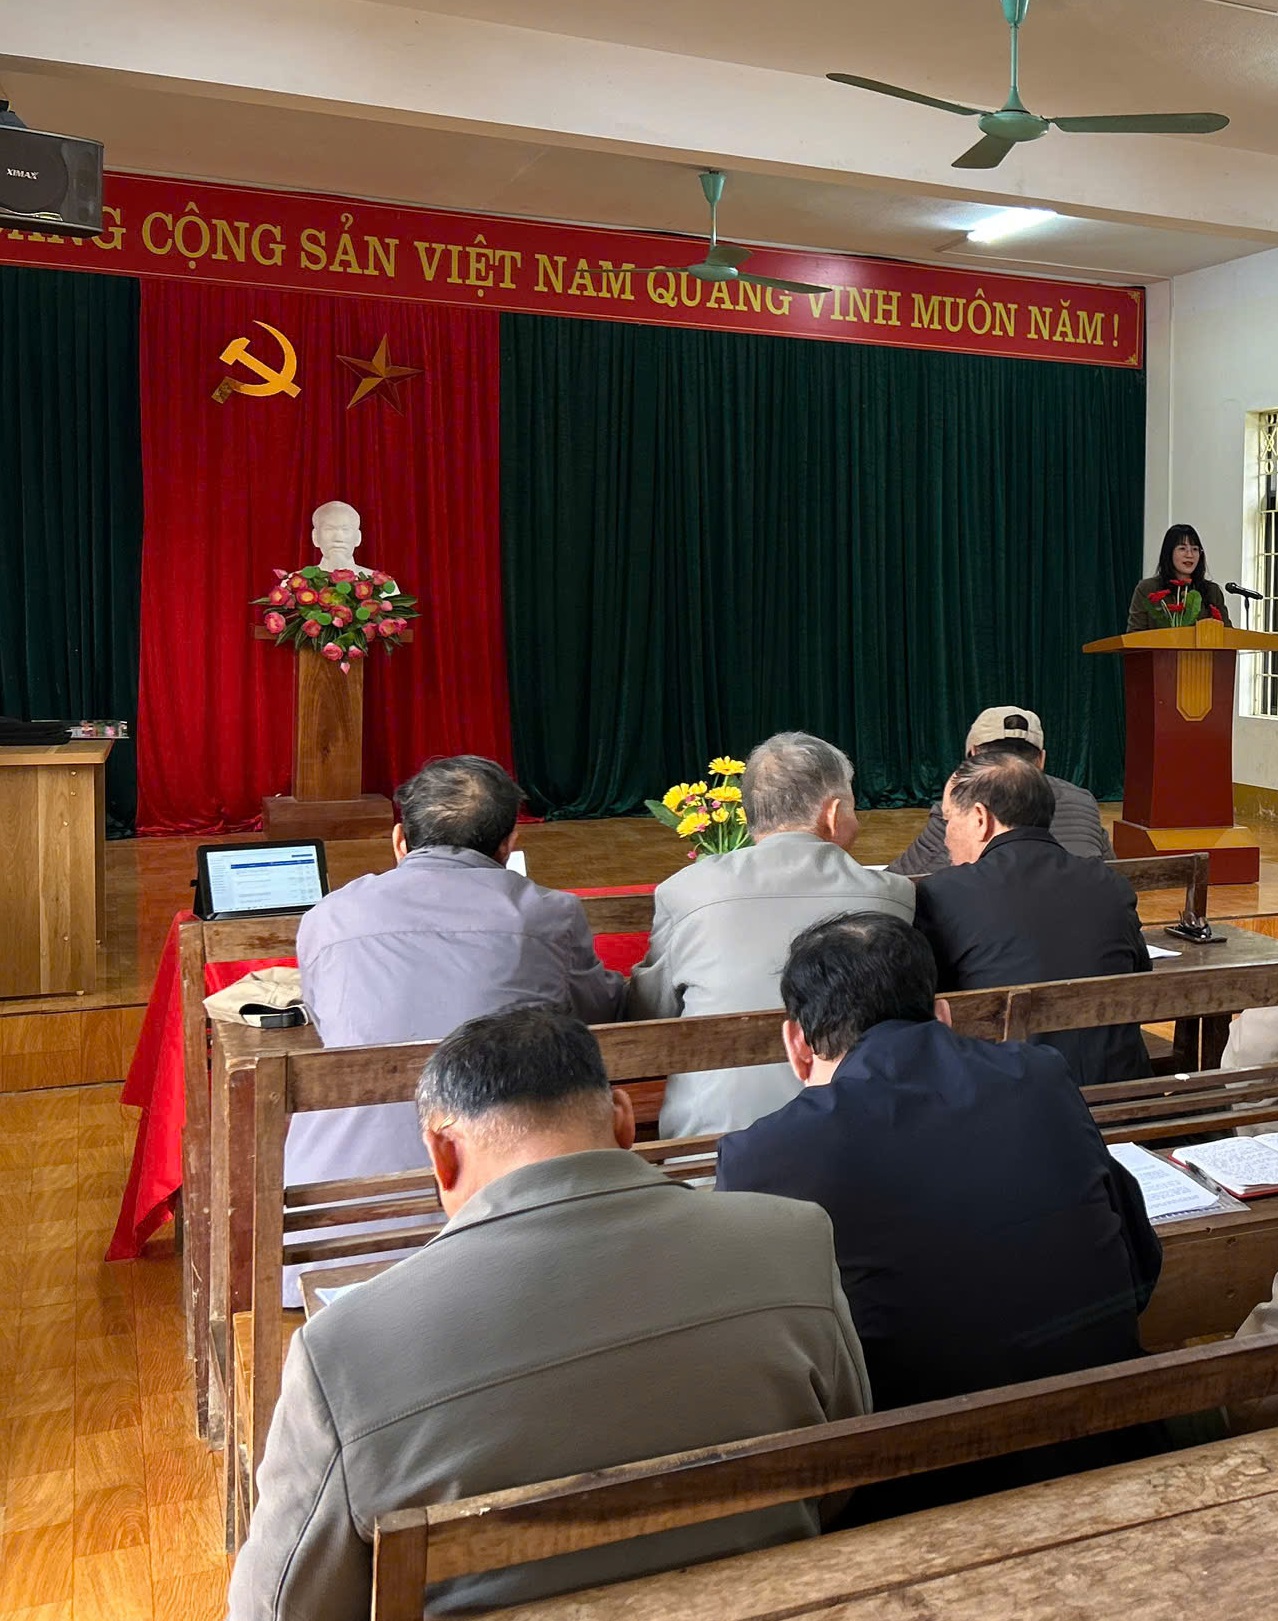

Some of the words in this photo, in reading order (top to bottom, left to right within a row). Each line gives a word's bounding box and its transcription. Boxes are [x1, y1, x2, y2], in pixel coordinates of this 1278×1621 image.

[7, 168, 38, 180] XIMAX
[142, 202, 287, 269] CỘNG
[301, 213, 398, 278] SẢN
[414, 234, 522, 298] VIỆT
[534, 254, 636, 300] NAM
[646, 270, 794, 316] QUANG
[808, 287, 902, 328] VINH
[911, 288, 1019, 338] MUÔN
